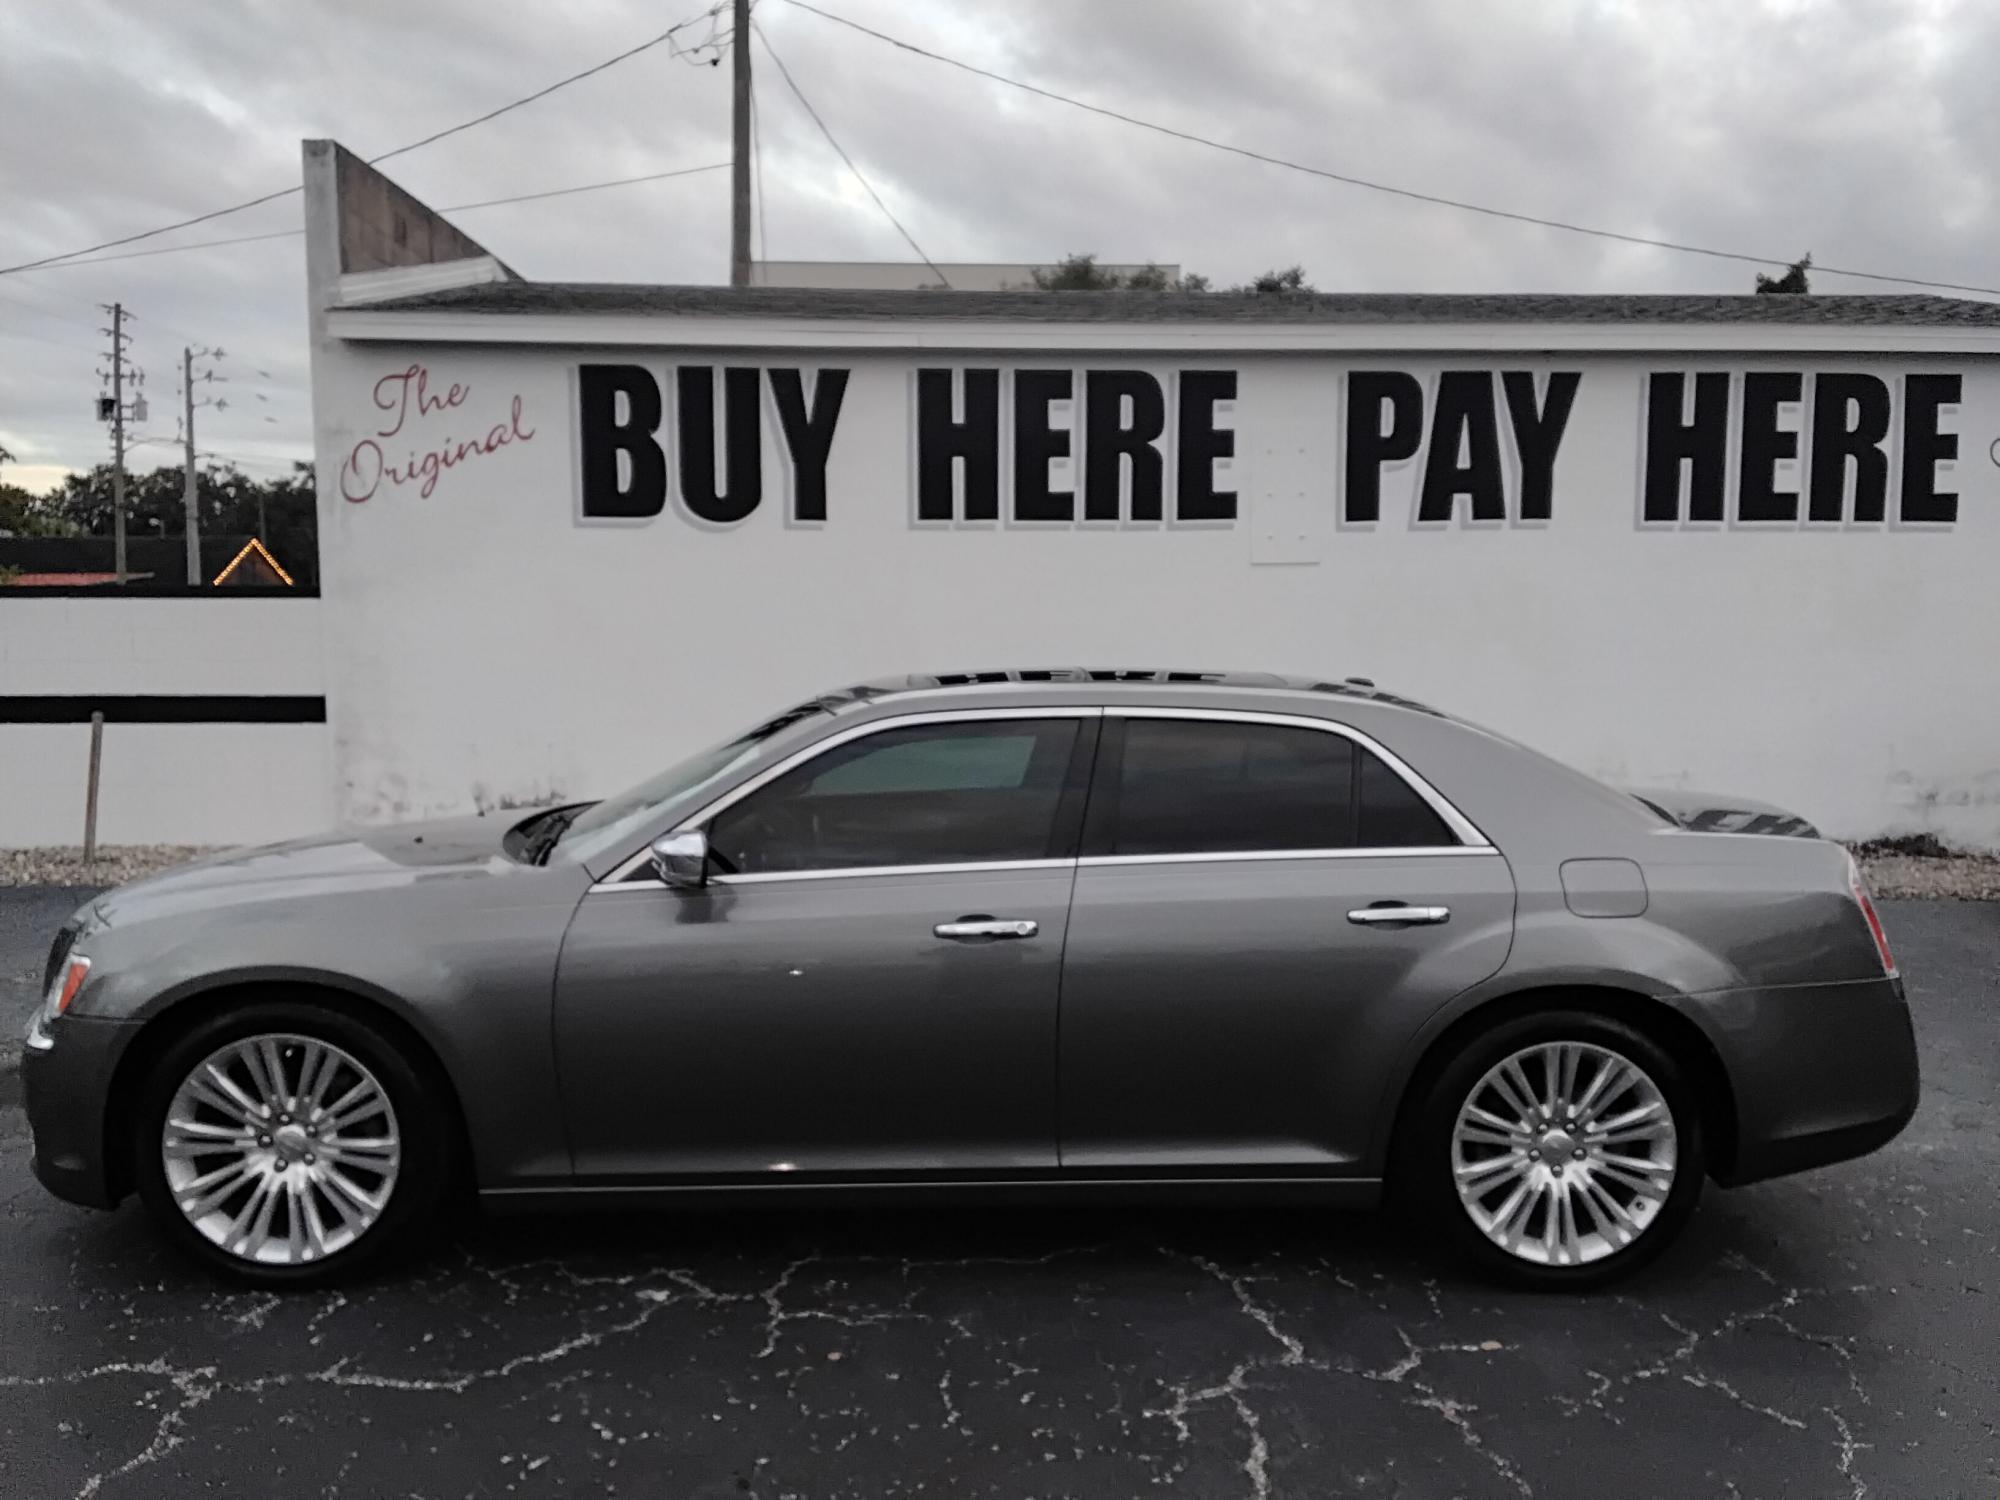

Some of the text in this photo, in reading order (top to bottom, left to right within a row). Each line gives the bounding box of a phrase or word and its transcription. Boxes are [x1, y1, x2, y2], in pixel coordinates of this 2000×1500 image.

[340, 394, 536, 504] Original
[373, 364, 470, 437] The
[577, 363, 1963, 523] BUY HERE PAY HERE
